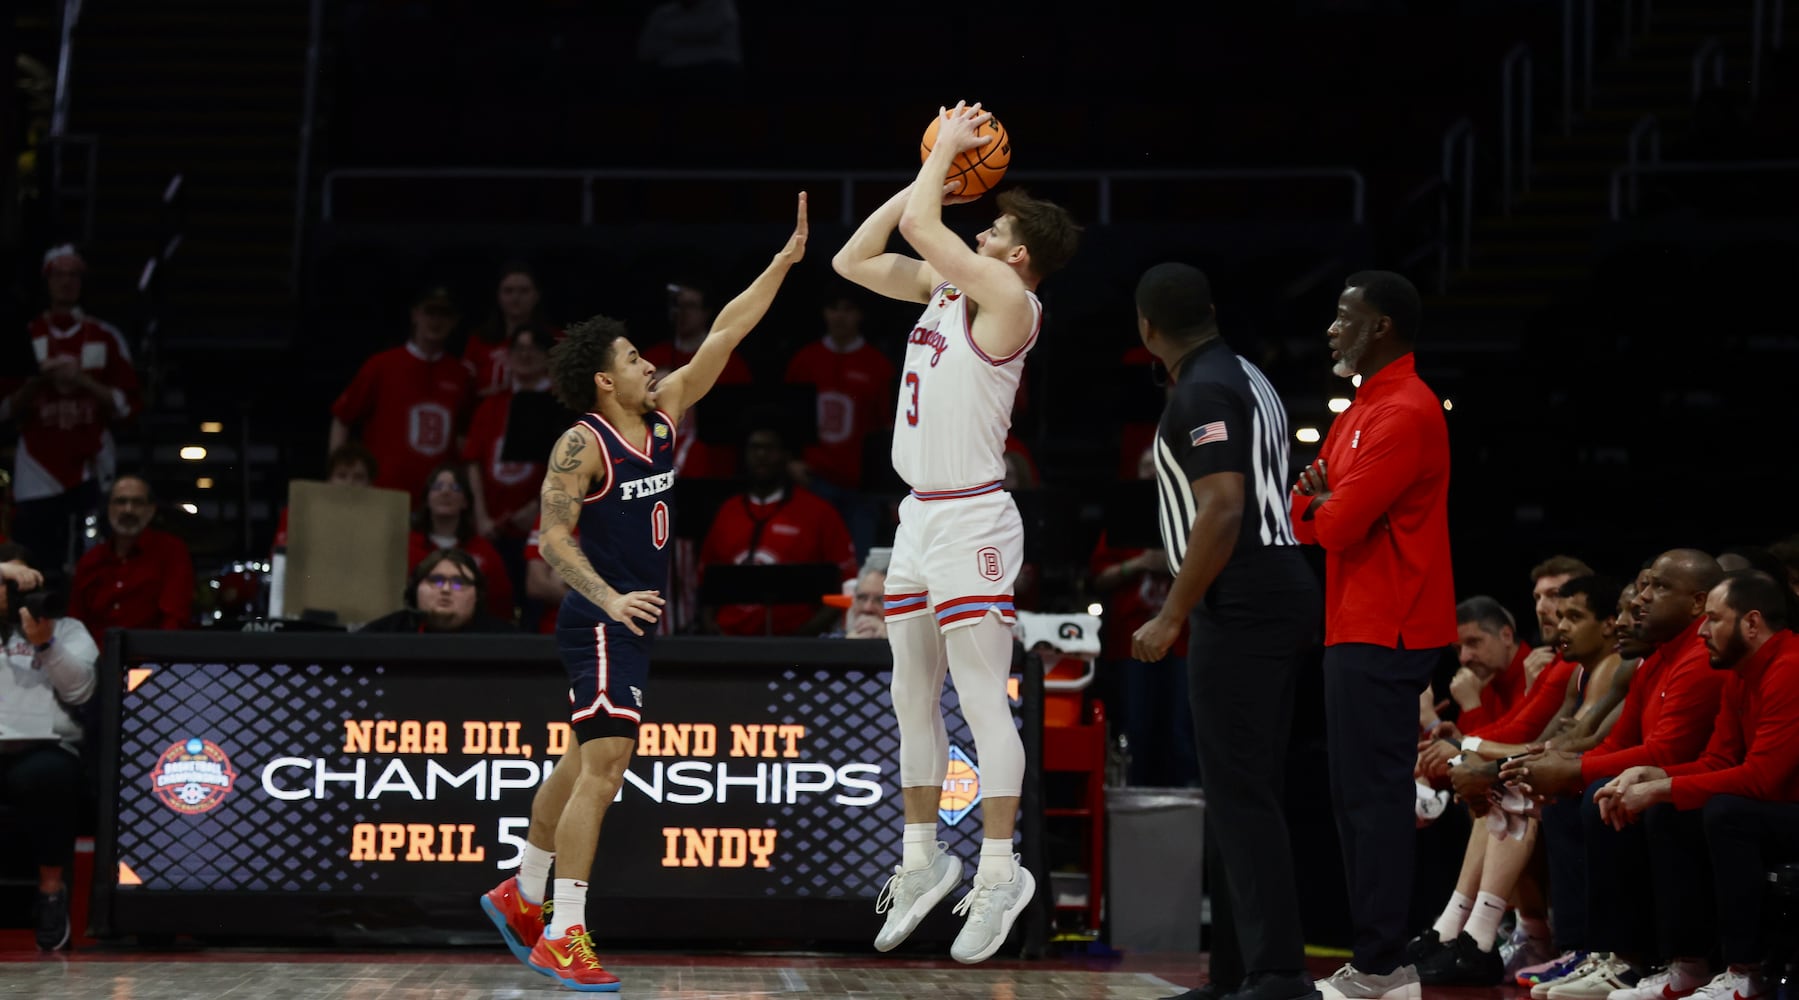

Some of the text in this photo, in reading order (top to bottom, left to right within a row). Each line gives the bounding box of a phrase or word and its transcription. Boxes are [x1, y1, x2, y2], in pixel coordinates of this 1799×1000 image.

[905, 371, 920, 427] 3
[651, 500, 669, 550] 0
[343, 720, 448, 754] NCAA
[462, 721, 532, 758] DII,
[637, 723, 717, 757] AND
[729, 724, 805, 758] NIT
[261, 757, 883, 806] CHAMPNSHIPS
[350, 817, 777, 870] APRIL 5 INDY
